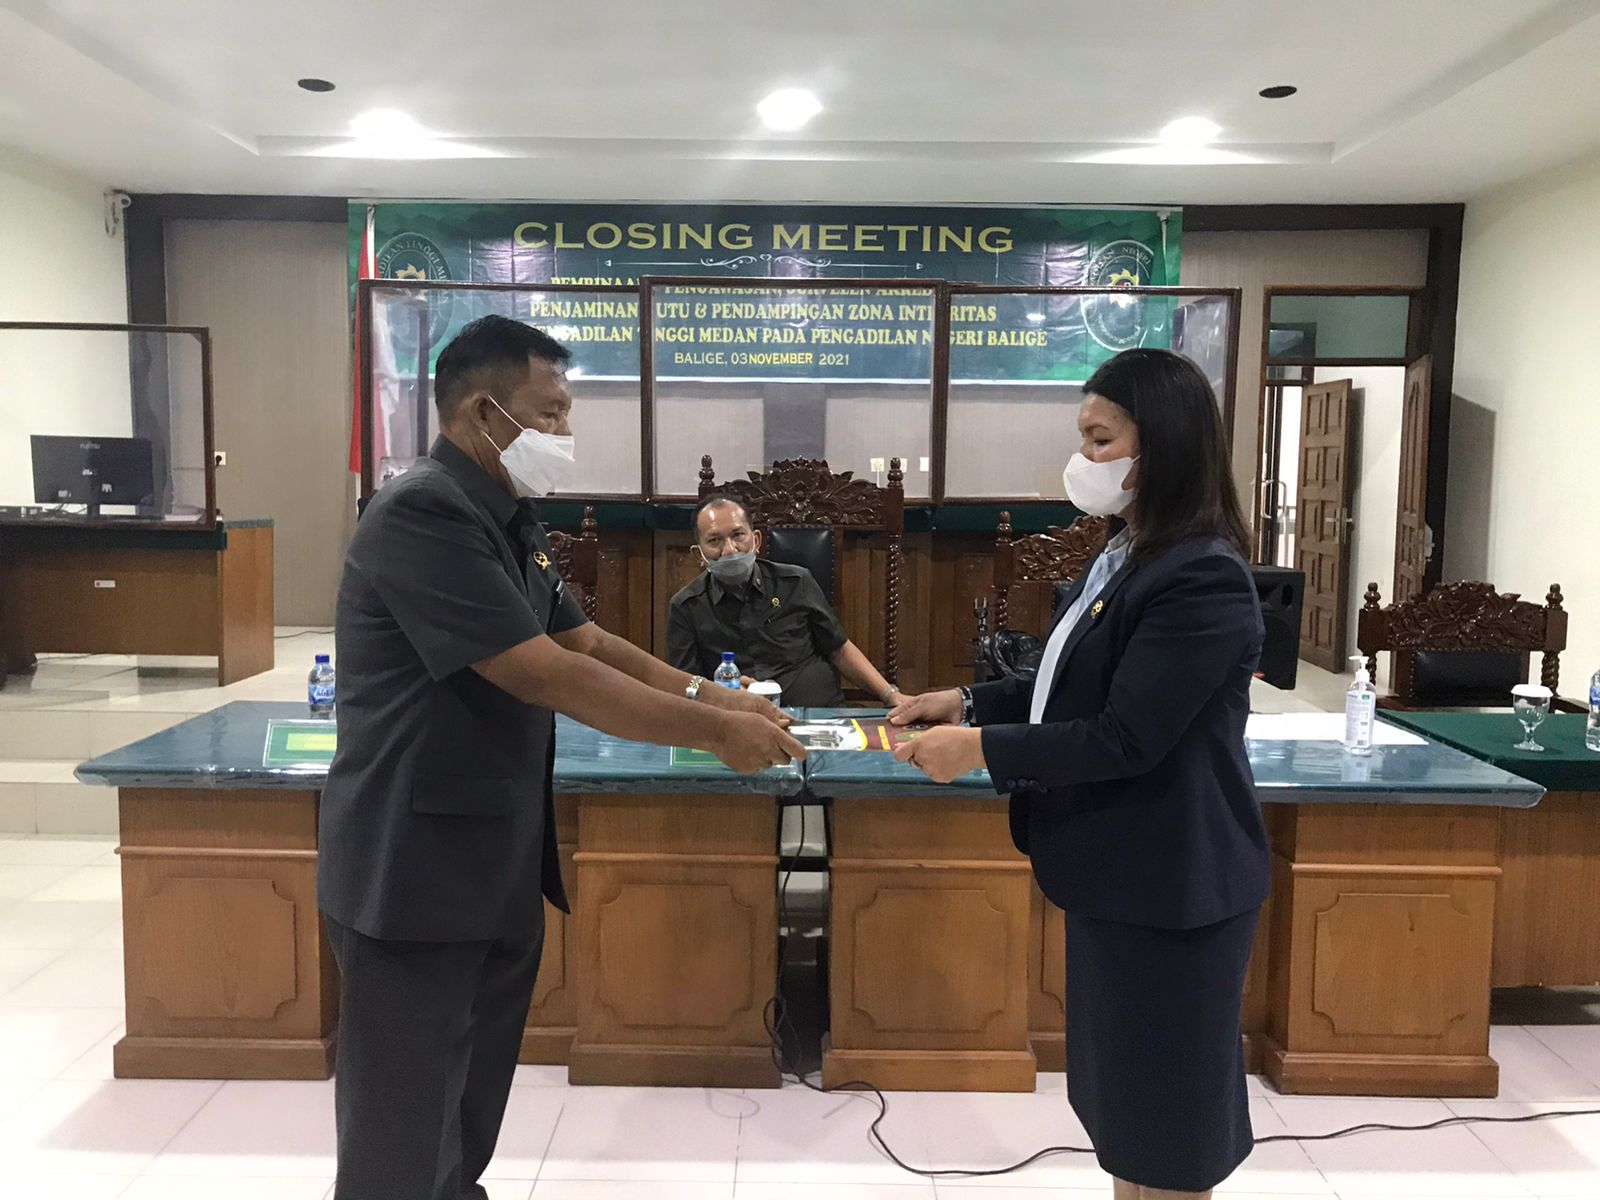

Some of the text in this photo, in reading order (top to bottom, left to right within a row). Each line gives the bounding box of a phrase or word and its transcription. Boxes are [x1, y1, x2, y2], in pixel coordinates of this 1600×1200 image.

[513, 221, 1014, 253] CLOSING MEETING
[530, 301, 639, 318] PENJAMINAN
[655, 302, 690, 319] UTU
[694, 303, 707, 318] &
[711, 303, 844, 320] PENDAMPINGAN
[848, 304, 894, 321] ZONA
[698, 327, 758, 343] MEDAN
[761, 328, 806, 344] PADA
[810, 328, 917, 345] PENGADILAN
[987, 331, 1048, 347] BALIGE
[818, 353, 850, 366] 2021
